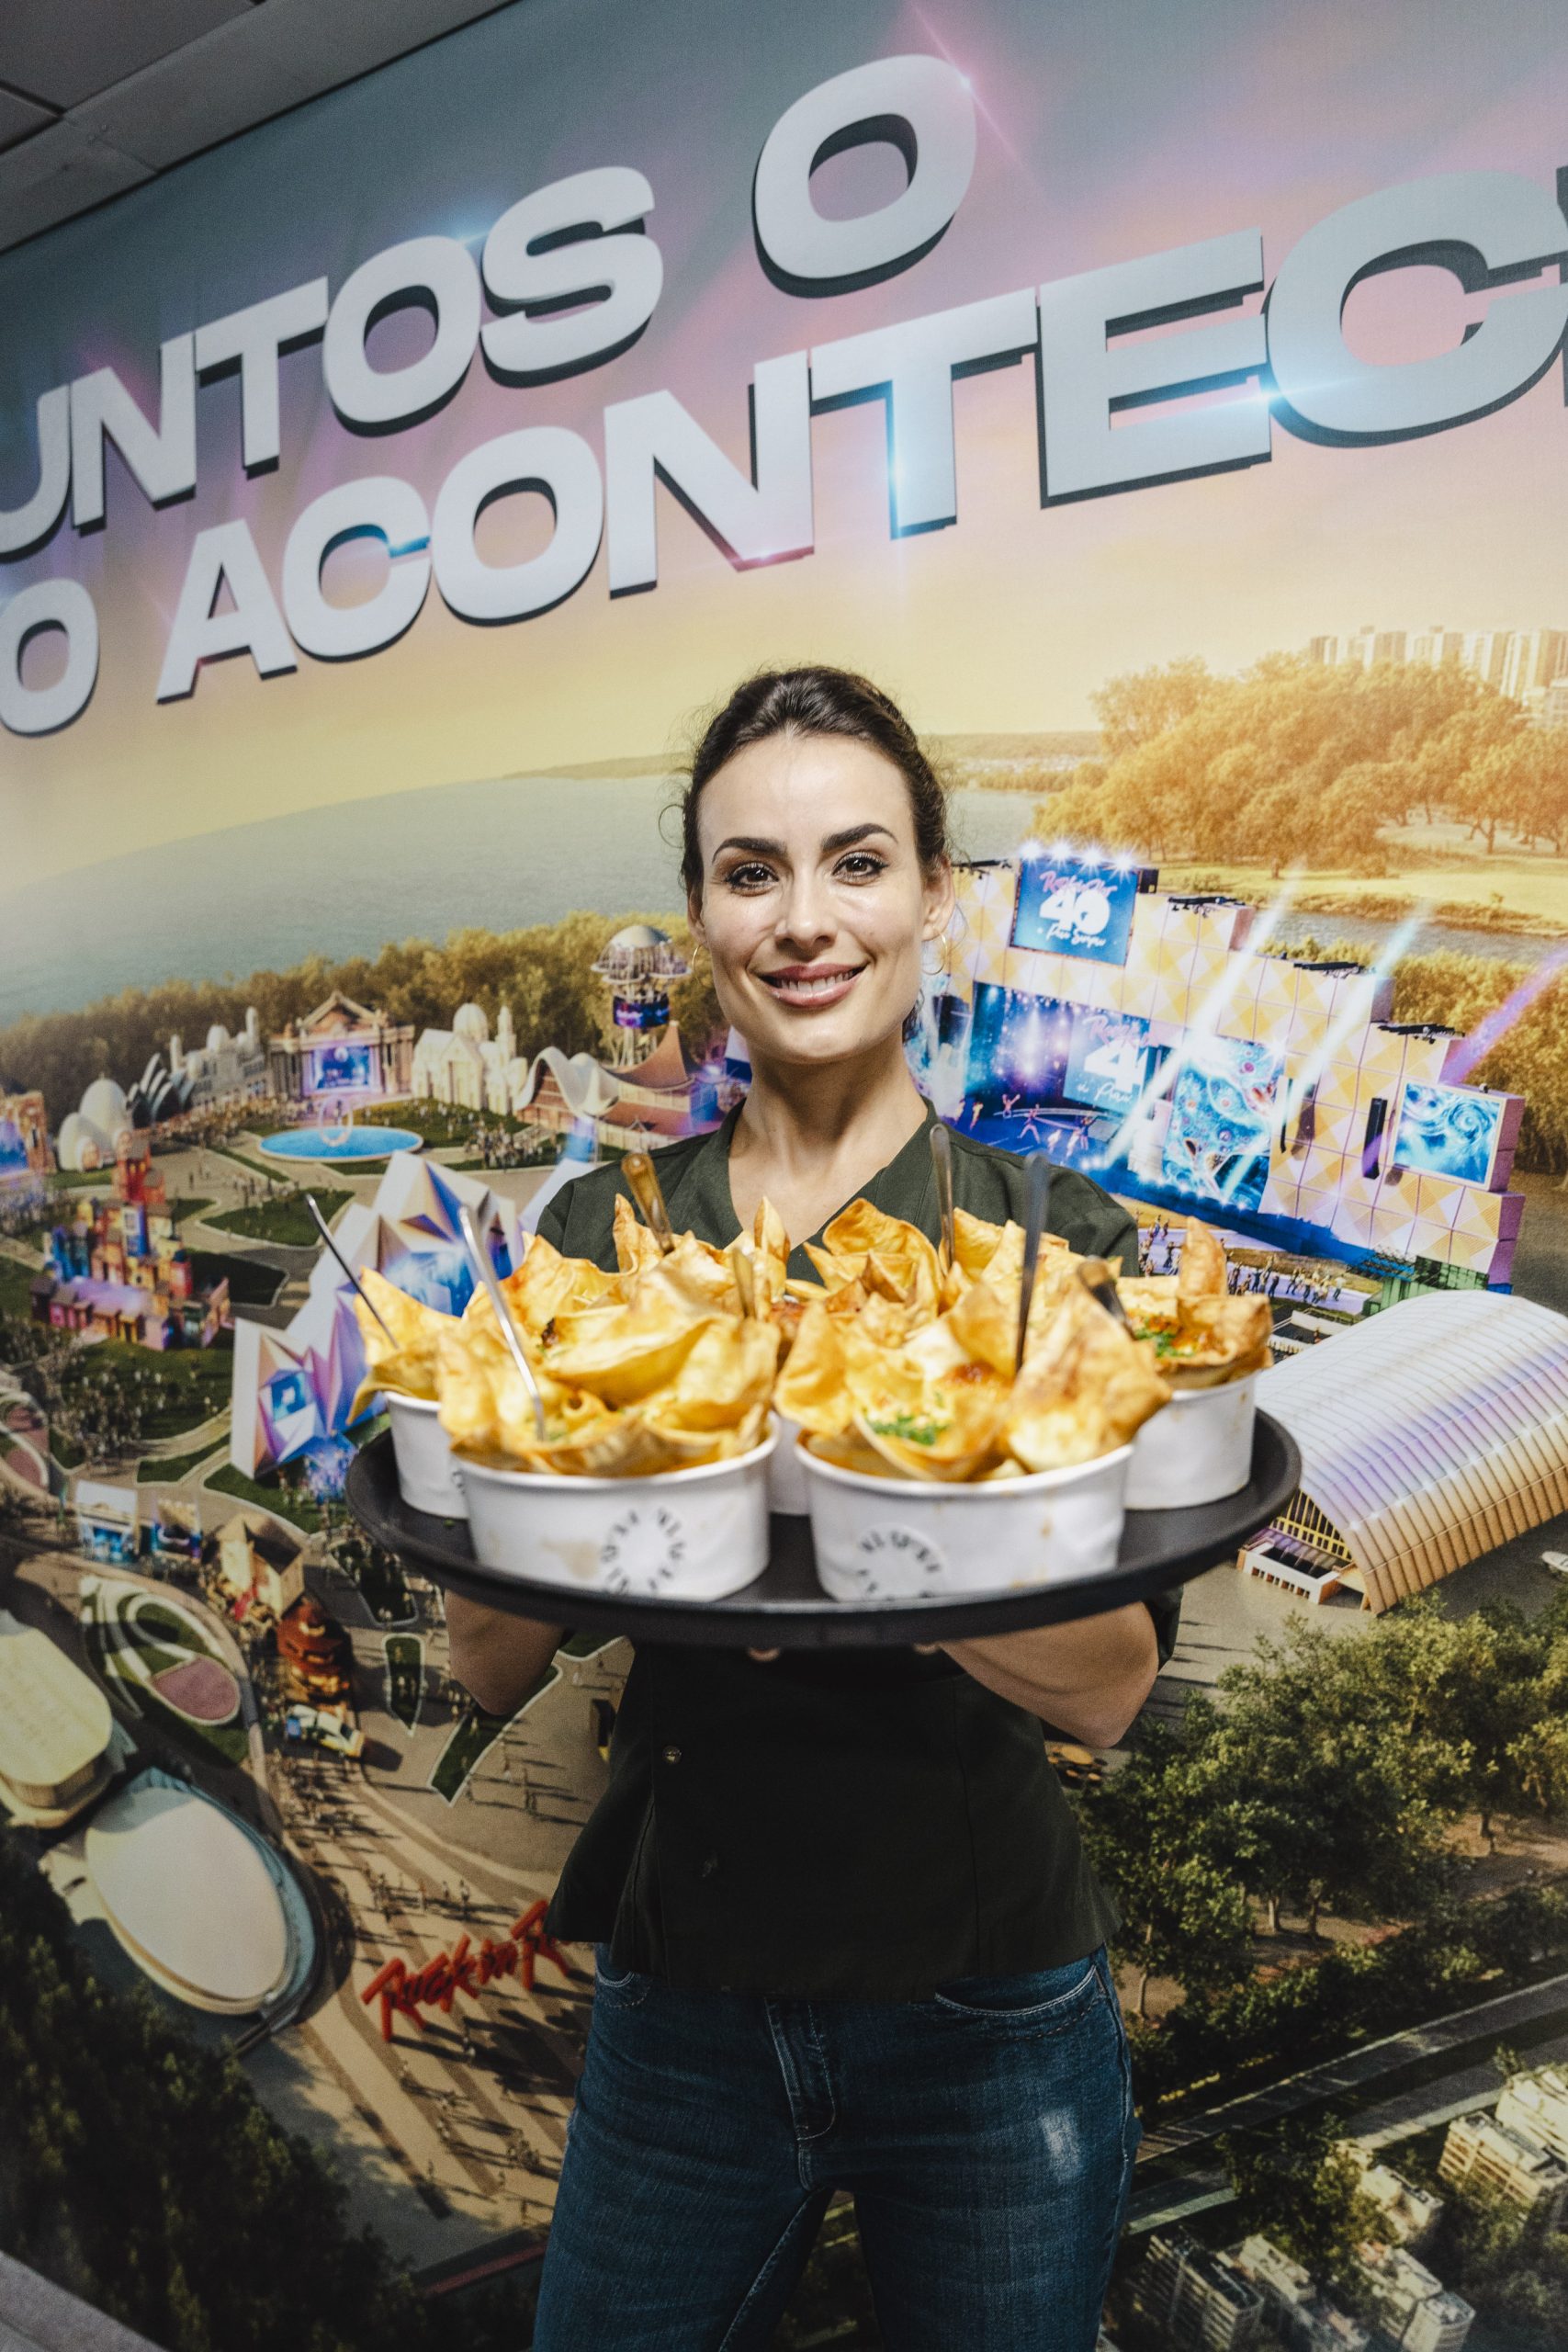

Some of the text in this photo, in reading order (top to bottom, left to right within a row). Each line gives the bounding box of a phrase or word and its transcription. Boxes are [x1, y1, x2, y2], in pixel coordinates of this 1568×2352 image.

[750, 54, 976, 298] O
[0, 167, 1568, 736] O ACONTEC
[1039, 886, 1111, 935] 40
